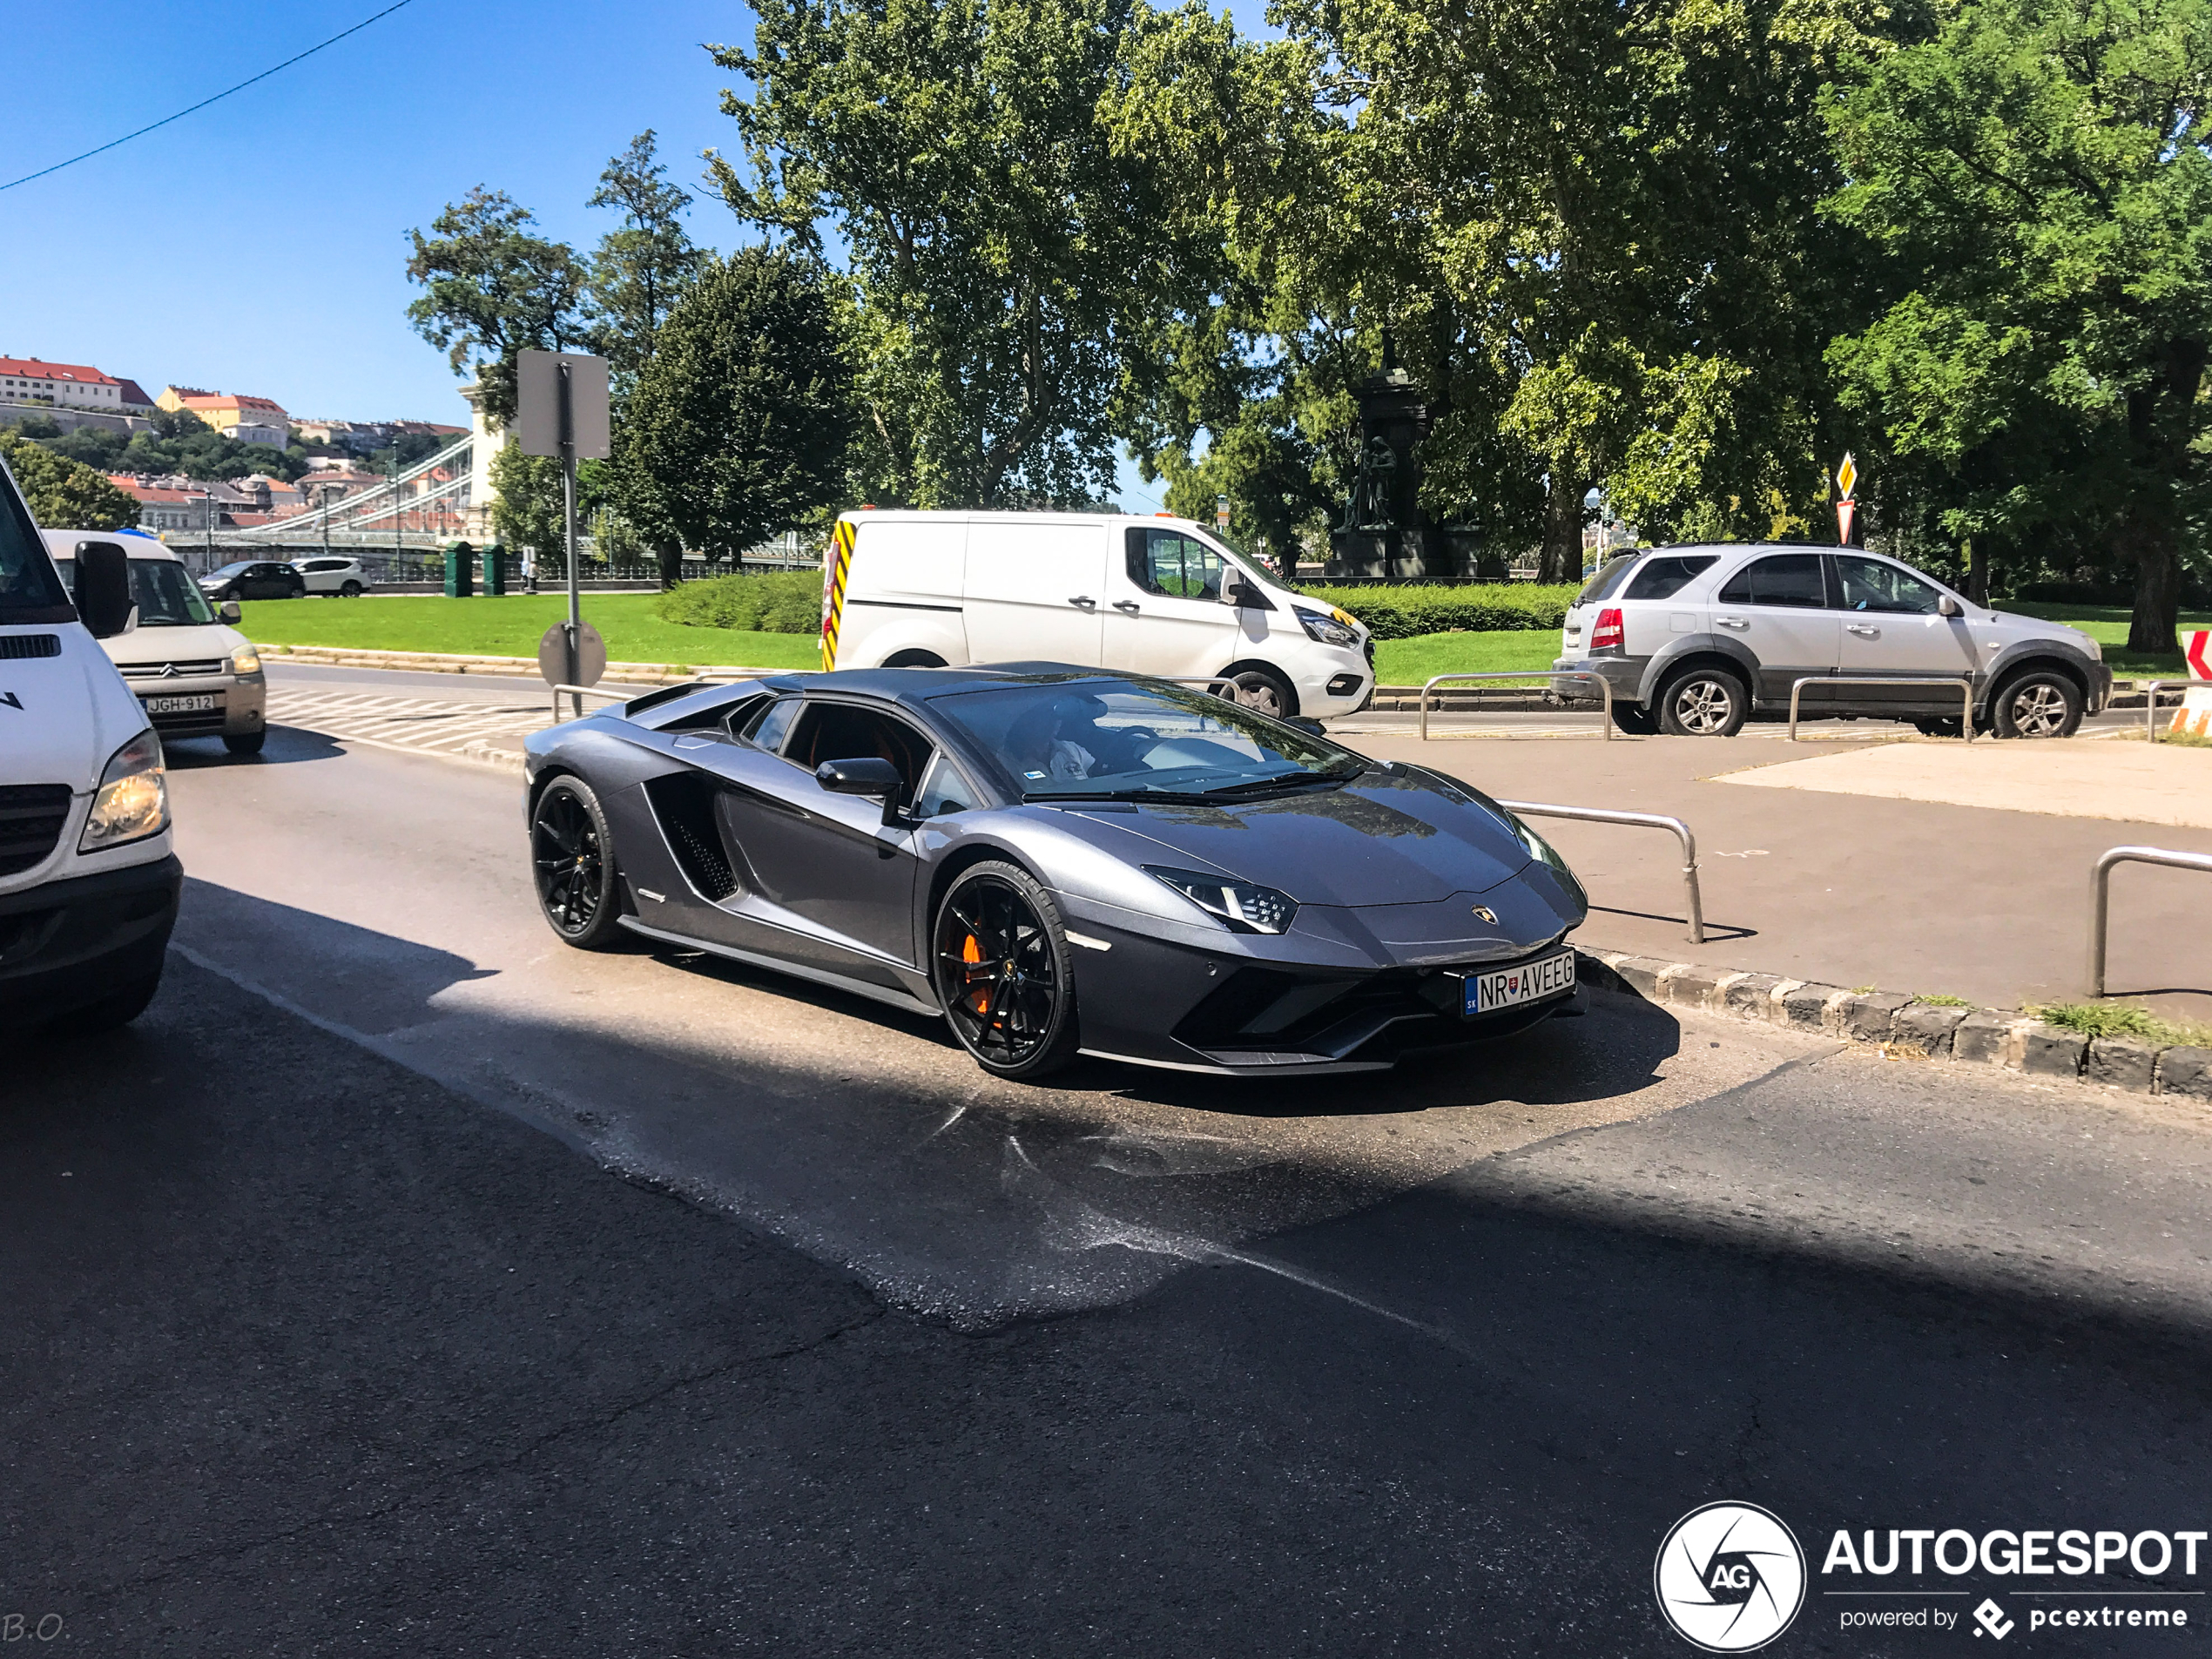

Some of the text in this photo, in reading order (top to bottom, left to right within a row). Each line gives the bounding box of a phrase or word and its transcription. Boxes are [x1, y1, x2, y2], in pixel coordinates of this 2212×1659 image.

[150, 697, 212, 711] JGH-912
[1480, 954, 1573, 1008] NR AVEEG
[1467, 999, 1476, 1009] SK
